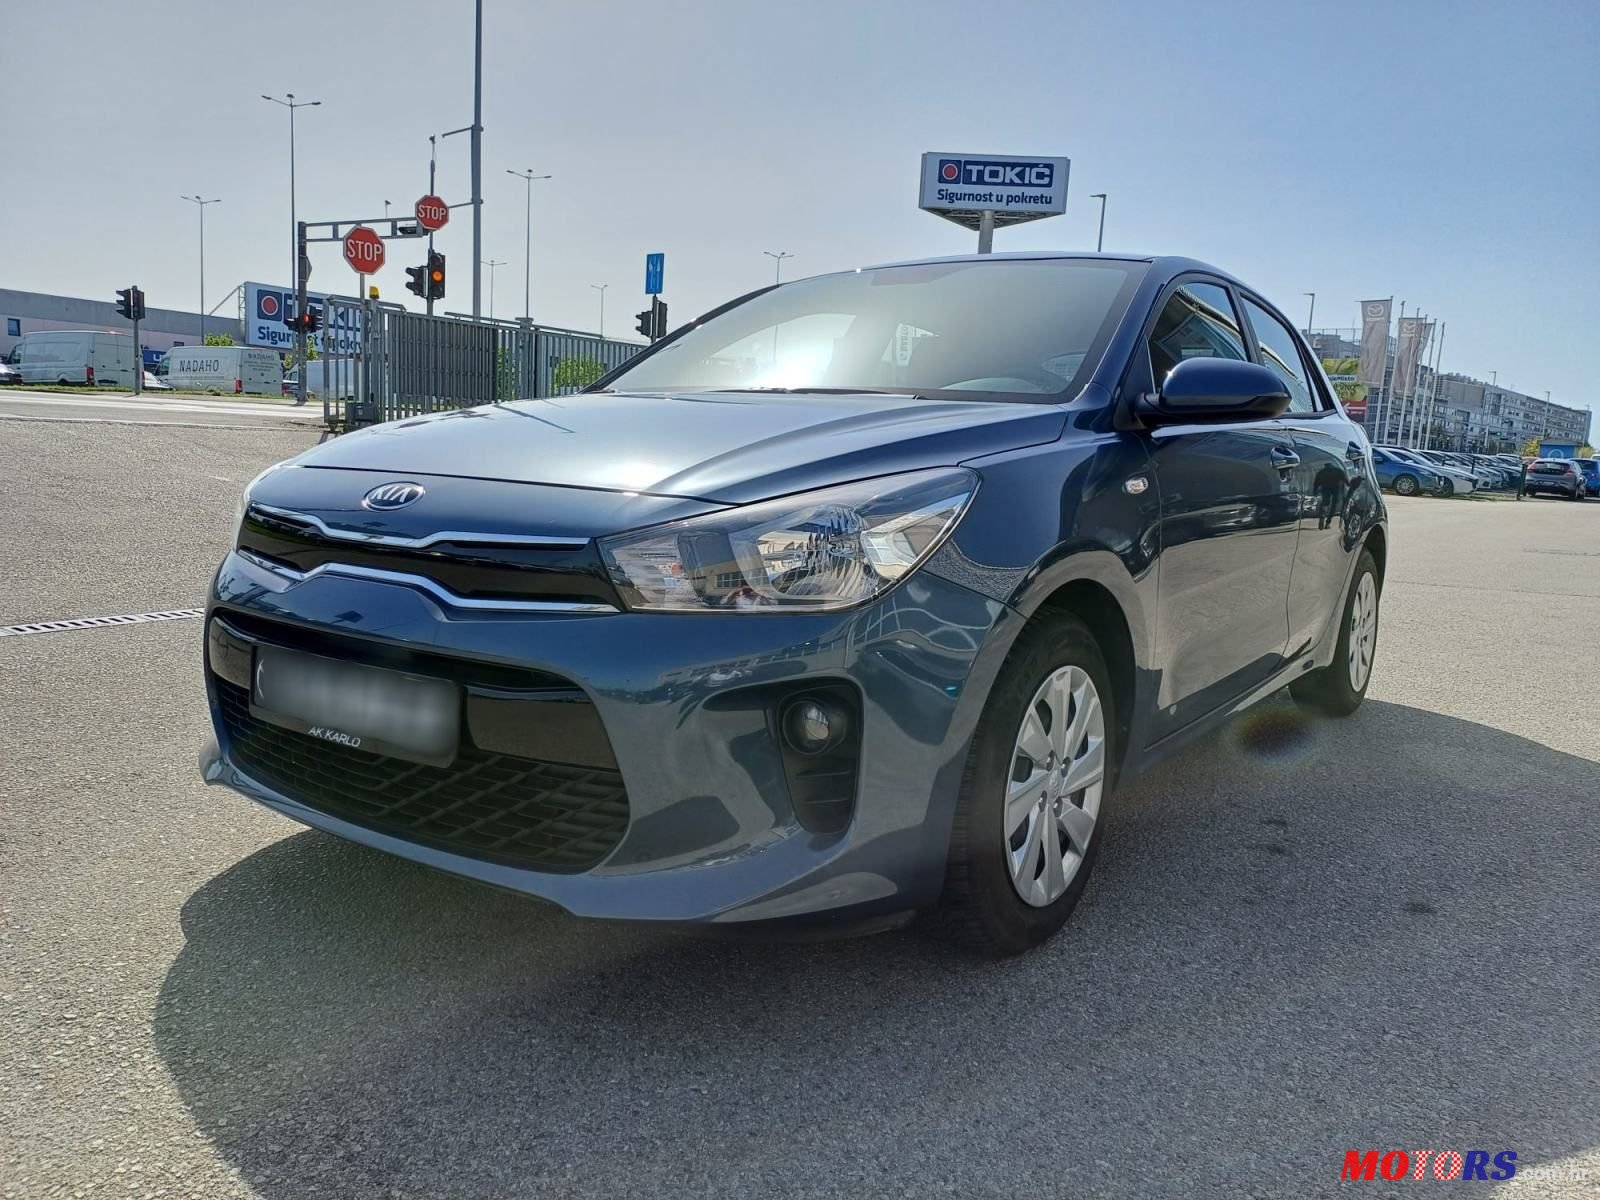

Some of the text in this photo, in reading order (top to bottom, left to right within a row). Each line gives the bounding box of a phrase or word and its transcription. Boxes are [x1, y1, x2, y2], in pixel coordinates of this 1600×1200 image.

[965, 164, 1051, 184] TOKIĆ
[937, 189, 1052, 206] Sigurnost u pokretu
[418, 204, 447, 220] STOP
[347, 239, 383, 261] STOP
[179, 359, 220, 372] NADAHO
[308, 726, 361, 747] AK KARLO
